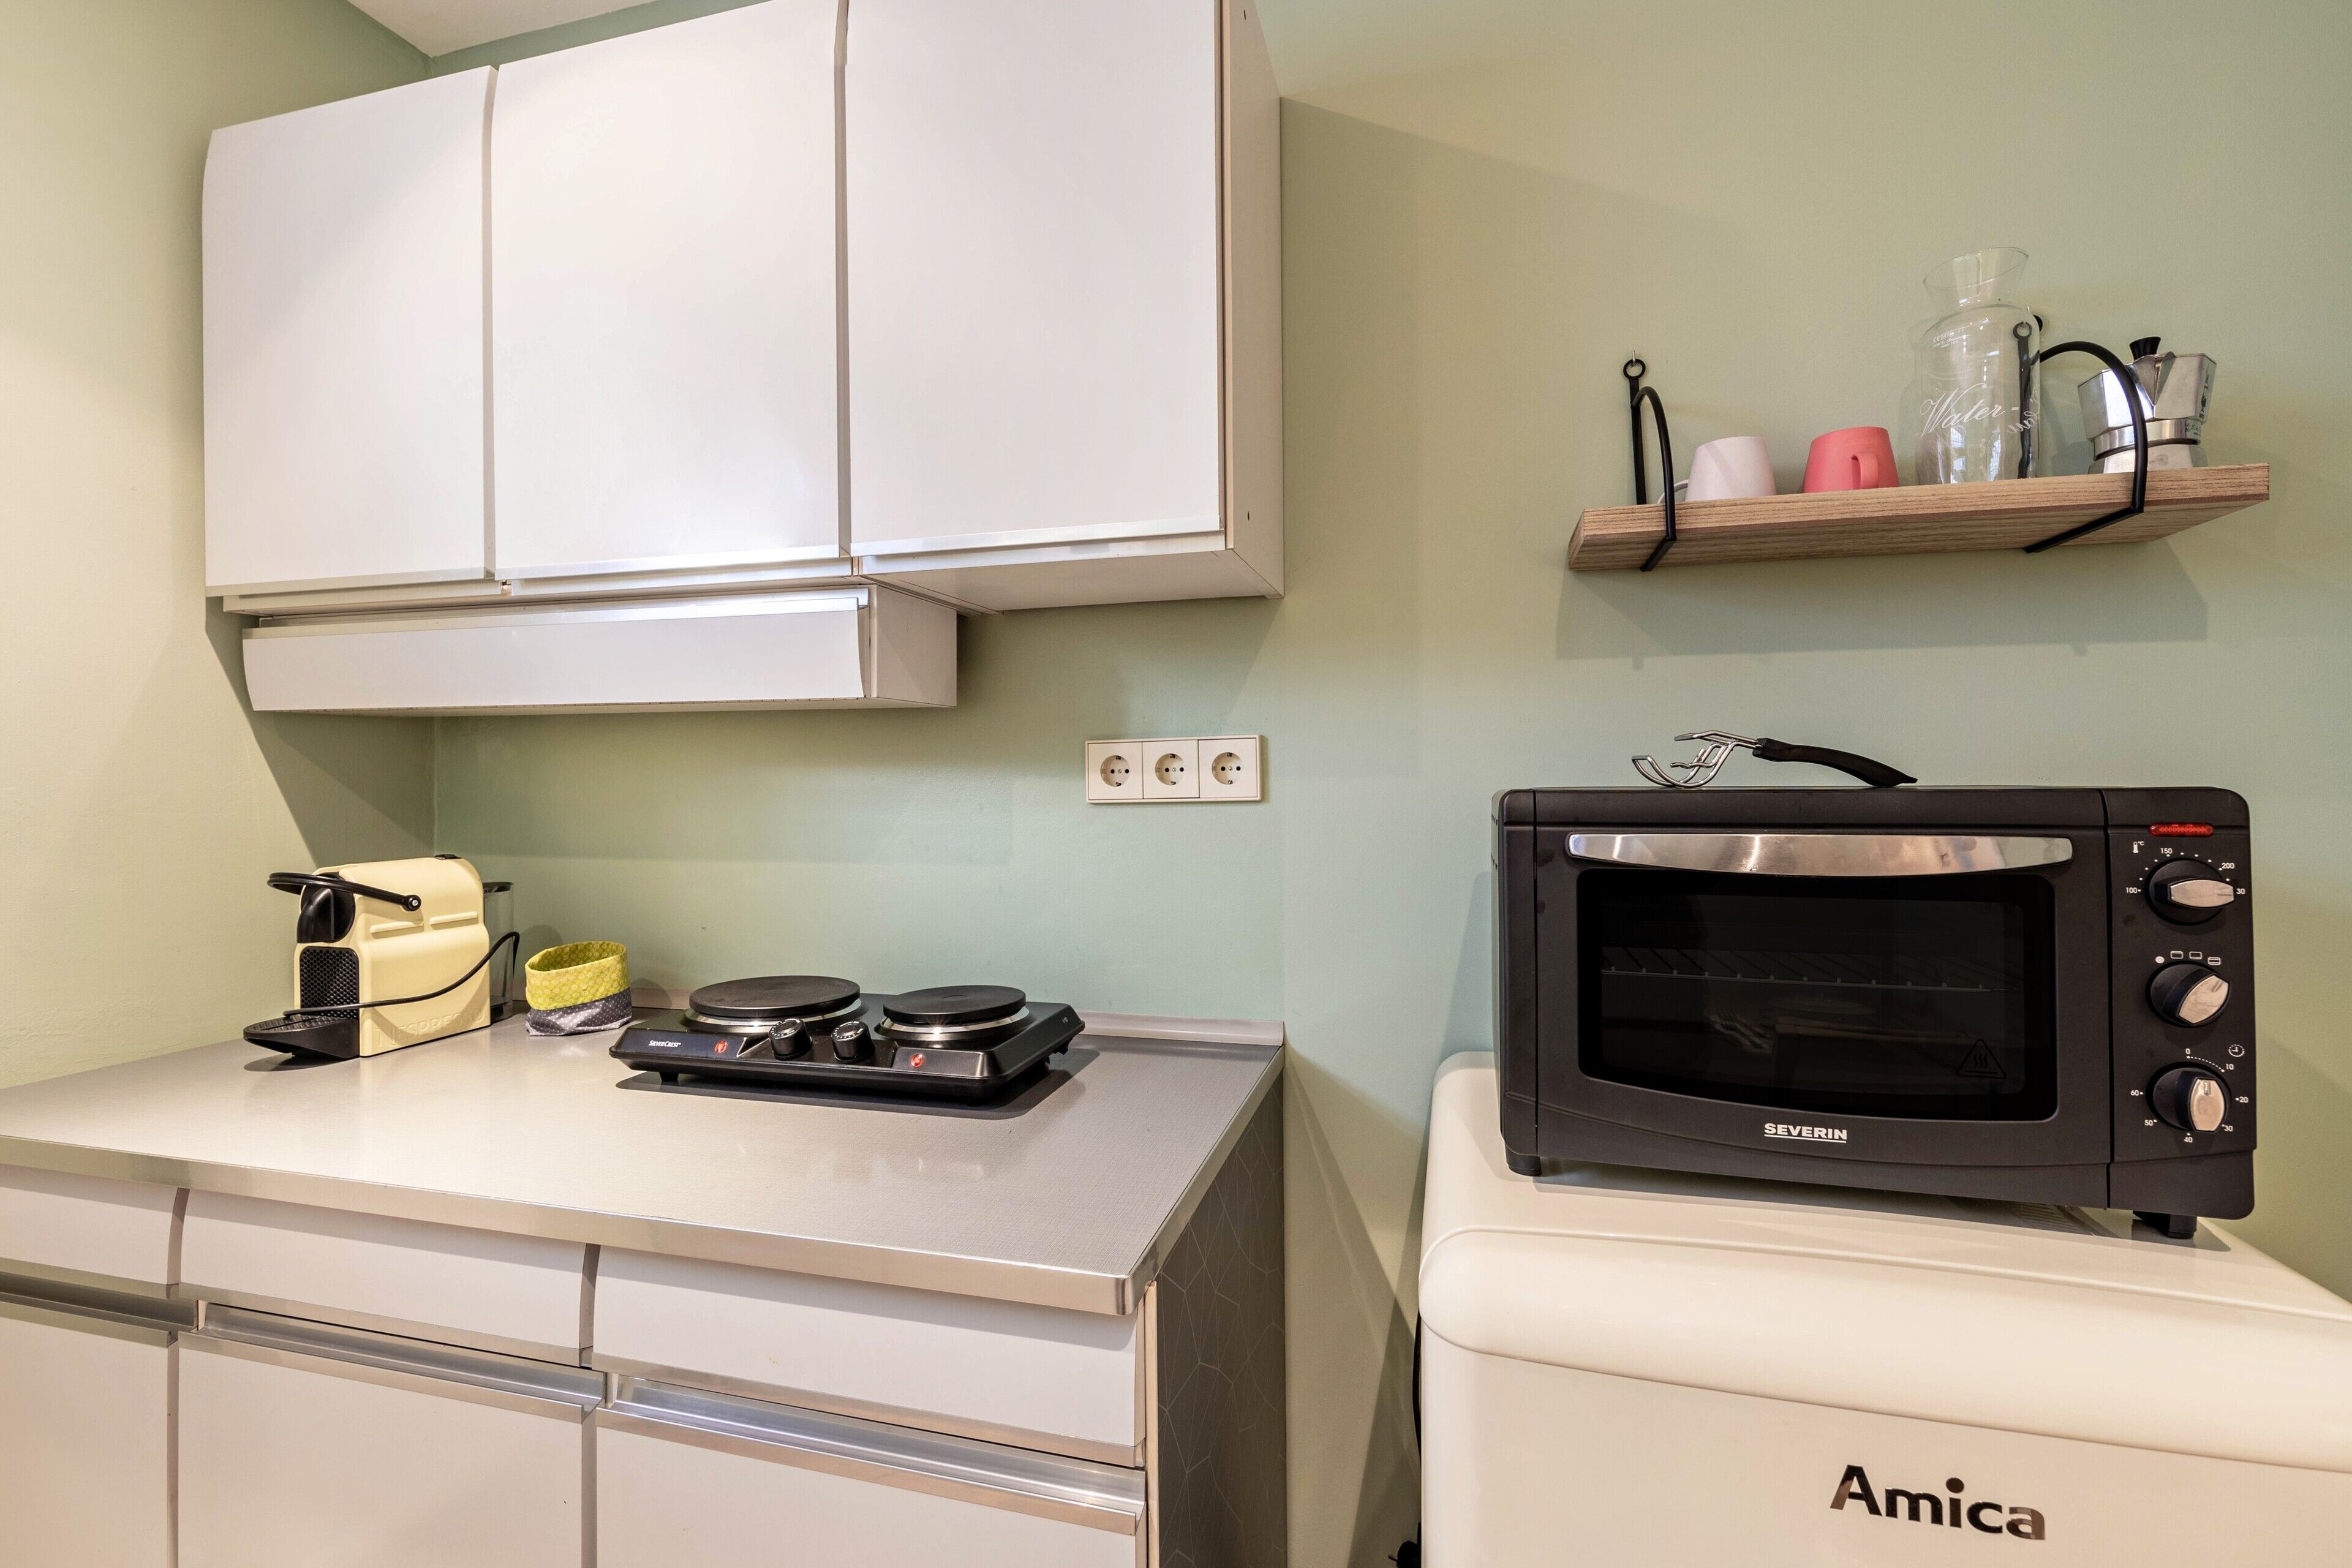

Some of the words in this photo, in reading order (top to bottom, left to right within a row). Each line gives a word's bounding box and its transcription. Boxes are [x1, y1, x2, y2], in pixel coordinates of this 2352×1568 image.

[1920, 383, 2006, 438] Water
[1764, 1123, 1847, 1140] SEVERIN
[1830, 1464, 2046, 1540] Amica
